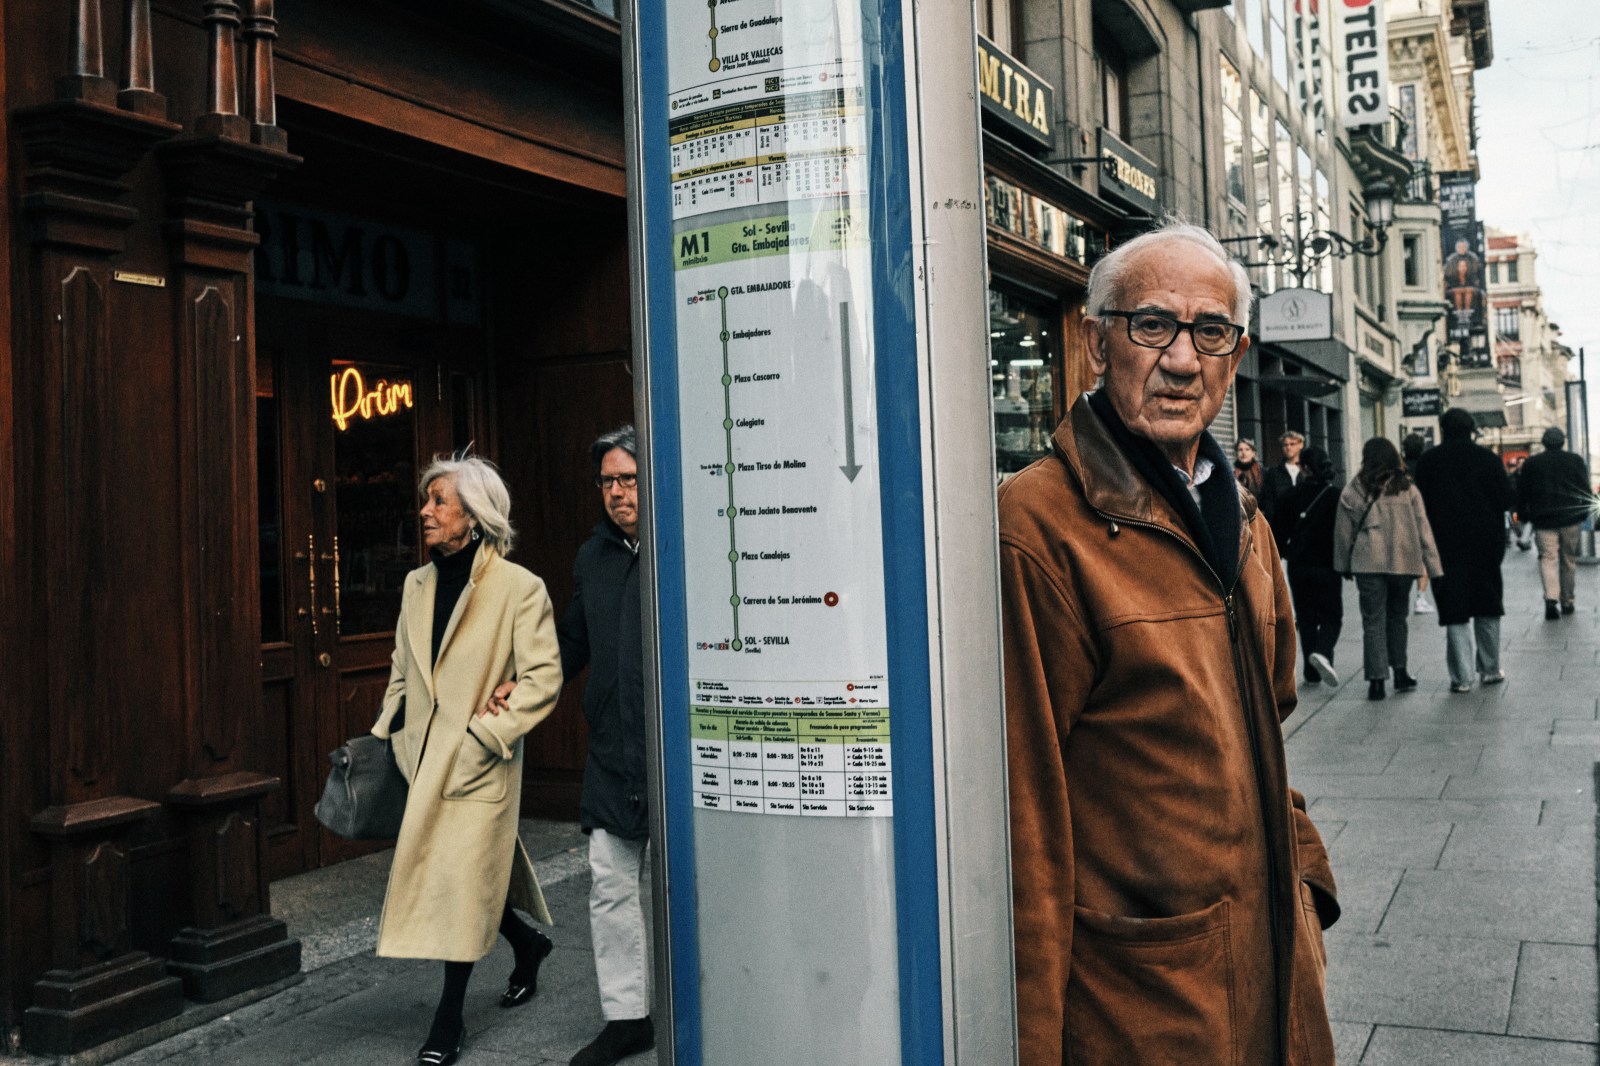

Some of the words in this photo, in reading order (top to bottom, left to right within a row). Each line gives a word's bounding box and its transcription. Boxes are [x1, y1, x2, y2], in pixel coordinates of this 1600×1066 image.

[720, 25, 738, 34] Sierra
[740, 20, 747, 29] de
[749, 15, 783, 28] Guadalupe
[722, 54, 739, 64] VILLA
[740, 52, 750, 61] DE
[750, 46, 783, 59] VALLECAS
[1344, 0, 1380, 115] TELES
[977, 45, 1049, 136] MIRA
[1102, 147, 1156, 199] TRRONES
[743, 224, 756, 237] Sol
[766, 220, 795, 234] Sevilla
[681, 232, 710, 258] M1
[732, 242, 750, 254] Gta.
[752, 236, 809, 251] Embajadores
[730, 286, 746, 295] GTA.
[746, 280, 795, 294] EMBAJADORES
[732, 328, 771, 340] Embajadores
[734, 374, 752, 384] Plaza
[752, 372, 780, 382] Cascorro
[329, 366, 415, 431] Prim
[736, 418, 764, 428] Colegiata
[738, 462, 755, 472] Plaza
[756, 462, 772, 470] Tirso
[784, 460, 806, 470] Molina
[740, 507, 756, 516] Plaza
[758, 506, 780, 515] Jacinto
[782, 504, 817, 514] Benavente
[742, 552, 758, 560] Plaza
[760, 550, 790, 562] Canalejas
[743, 596, 768, 605] Carrera
[768, 596, 776, 604] de
[777, 596, 790, 604] San
[791, 595, 822, 604] Jerónimo
[744, 636, 756, 645] SOL
[763, 636, 789, 645] SEVILLA
